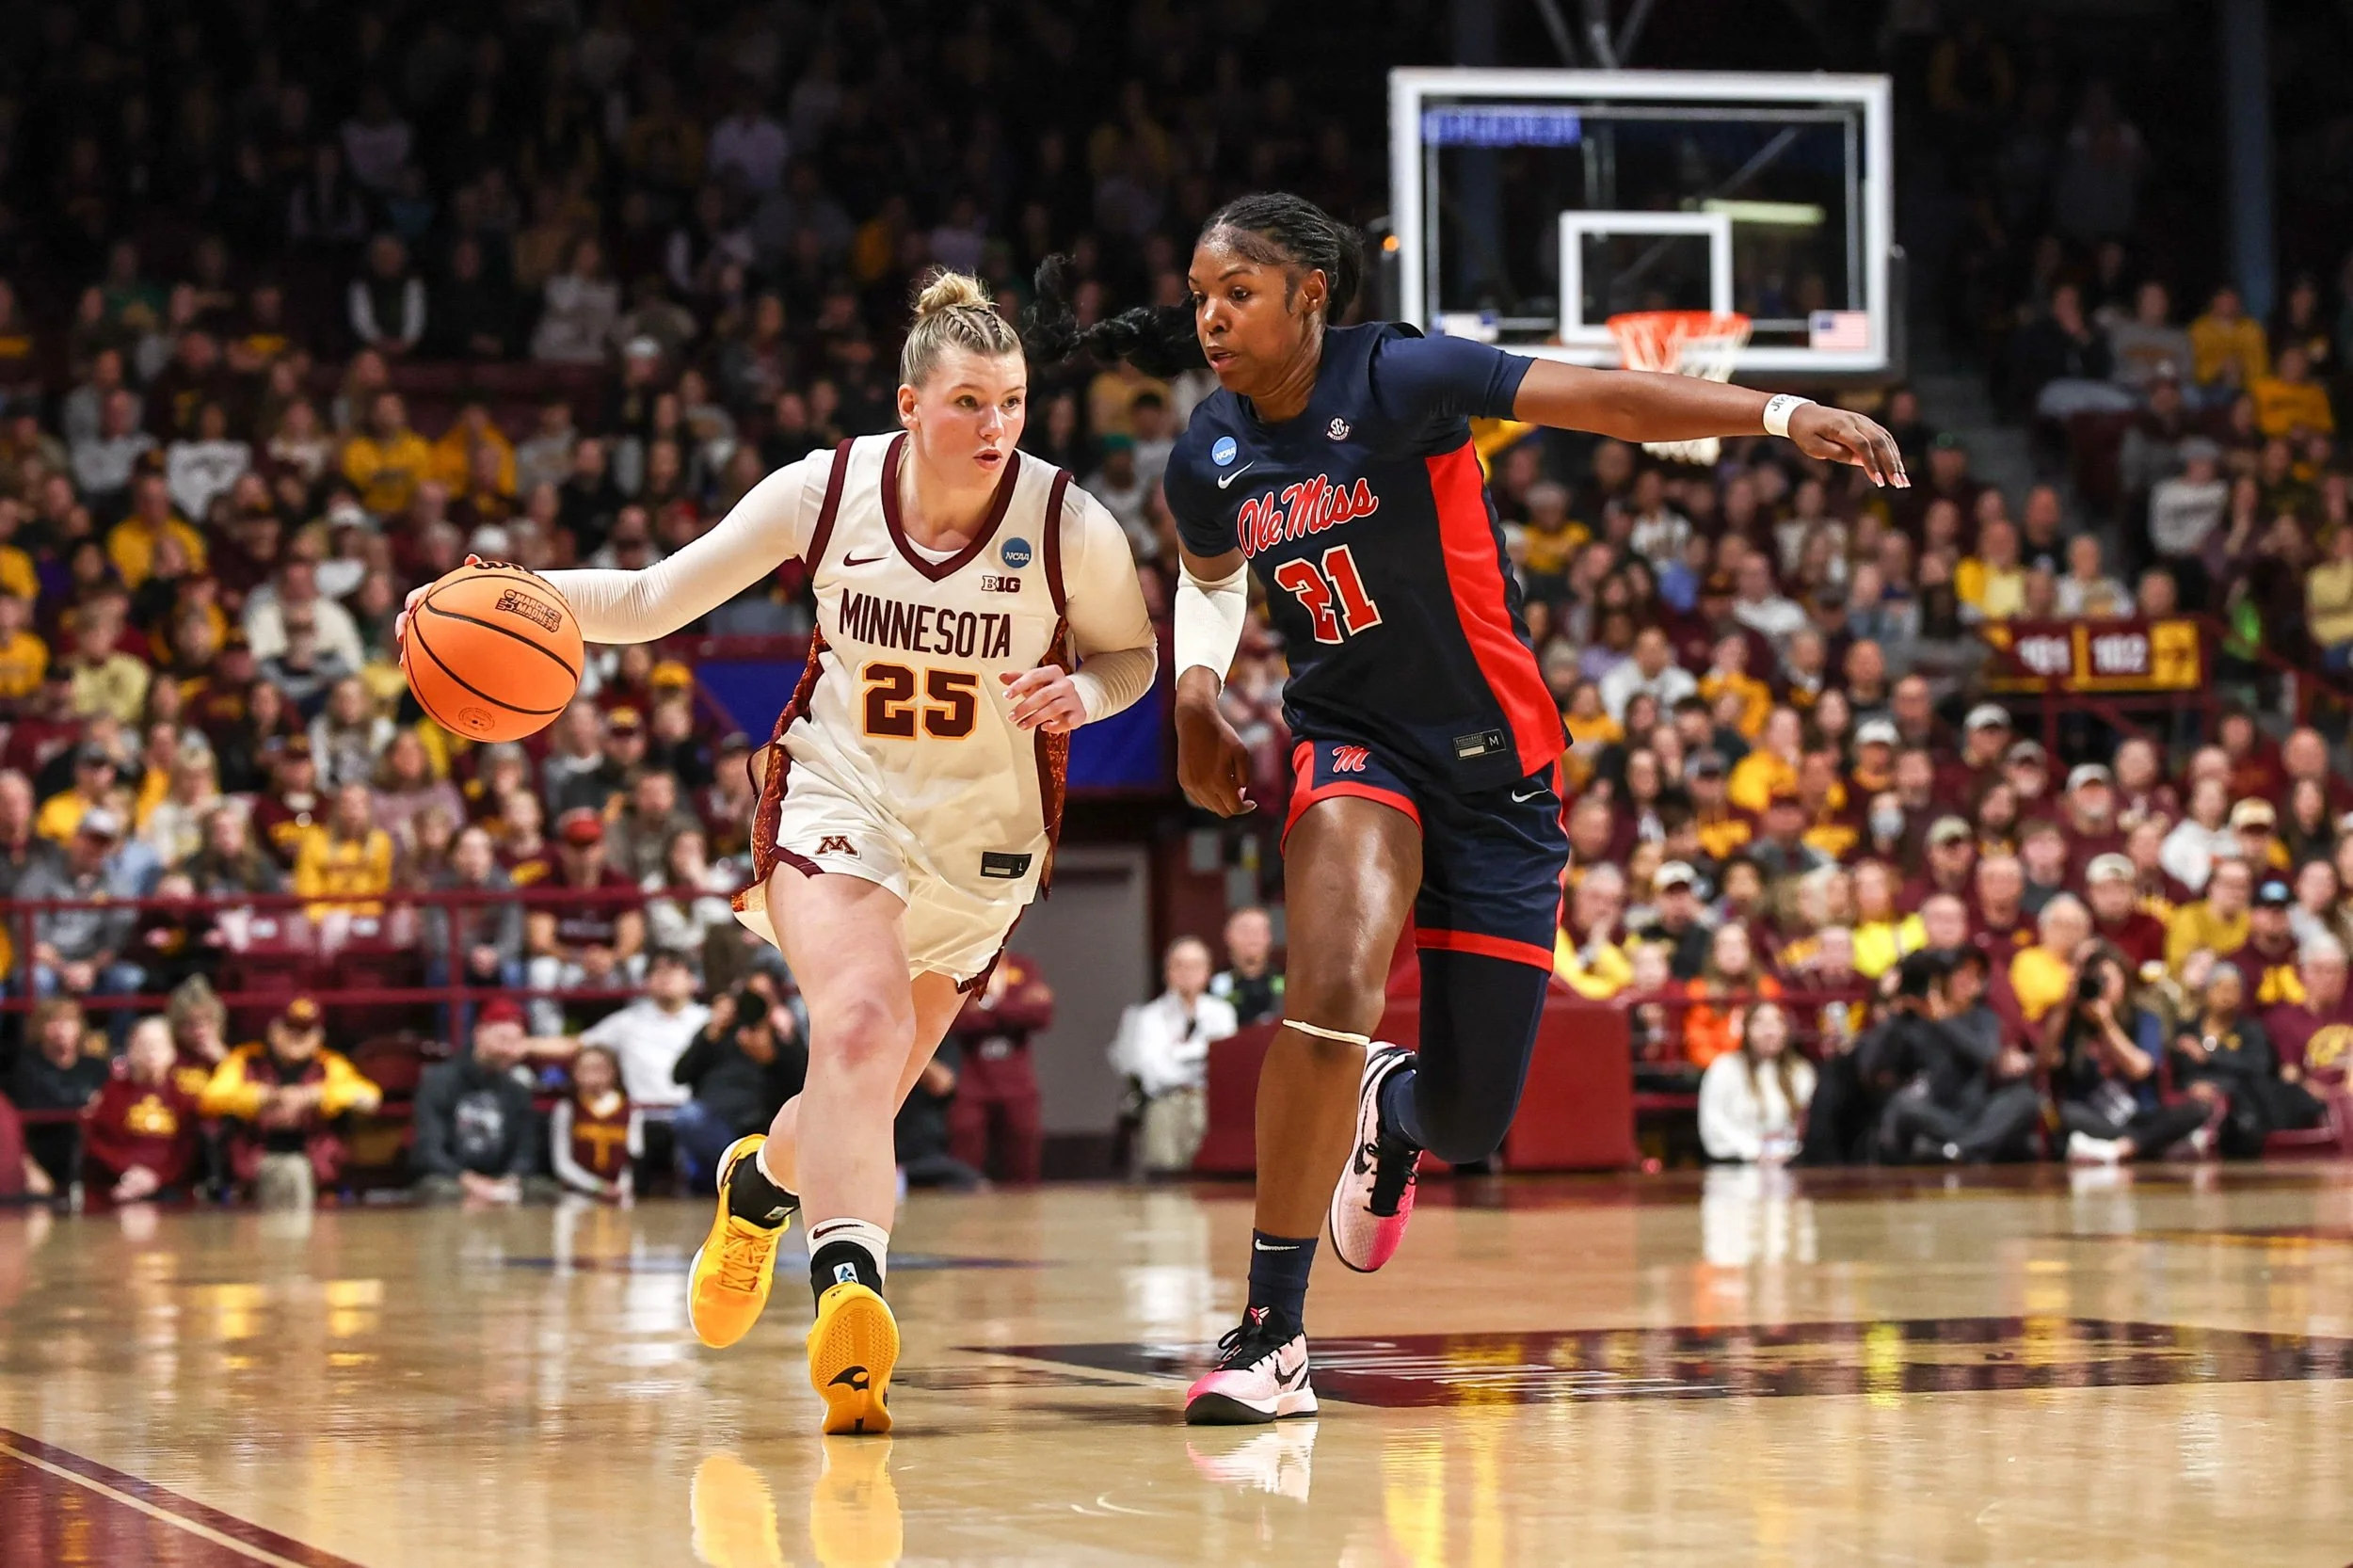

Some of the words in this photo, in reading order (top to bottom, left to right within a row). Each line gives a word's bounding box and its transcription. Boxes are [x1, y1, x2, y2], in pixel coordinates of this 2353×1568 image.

[1330, 417, 1345, 436] SEC
[1215, 446, 1237, 461] NCAA
[1237, 490, 1285, 560] Ole
[1281, 472, 1379, 542] Miss
[1004, 551, 1030, 562] NCAA
[515, 592, 549, 614] MARCH
[1273, 543, 1383, 646] 21
[516, 602, 561, 632] MADNESS
[839, 587, 1011, 659] MINNESOTA
[861, 660, 981, 742] 25
[1487, 734, 1499, 746] M
